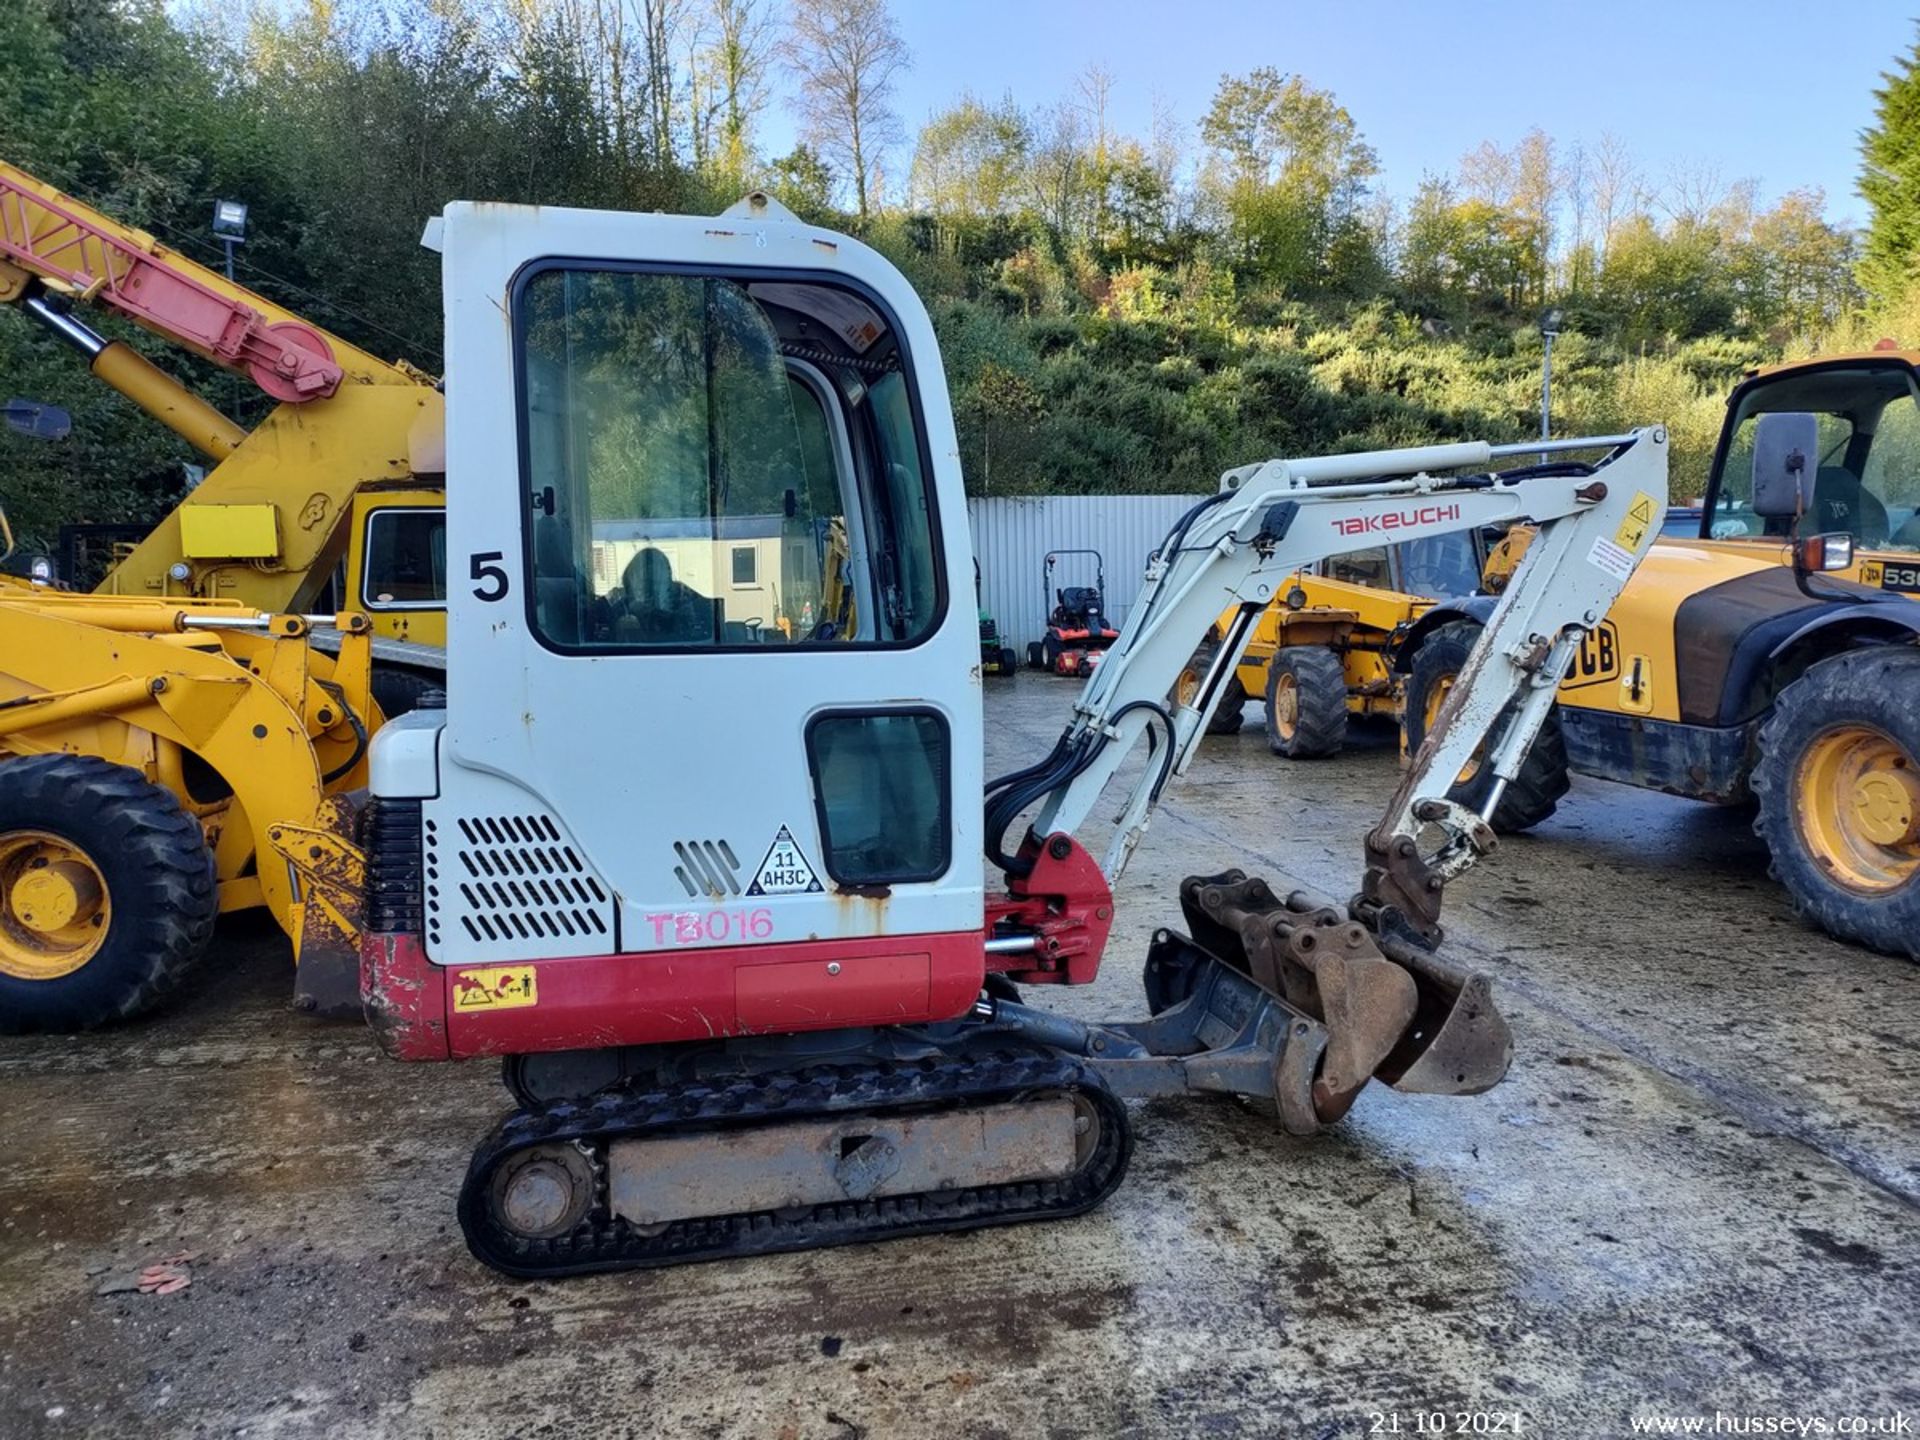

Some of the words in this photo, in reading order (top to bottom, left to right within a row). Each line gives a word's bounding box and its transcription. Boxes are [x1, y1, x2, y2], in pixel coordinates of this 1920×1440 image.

[470, 551, 509, 602] 5
[1884, 569, 1920, 586] 53
[775, 852, 795, 868] 11
[763, 870, 806, 886] AH3C
[645, 908, 773, 945] TB016
